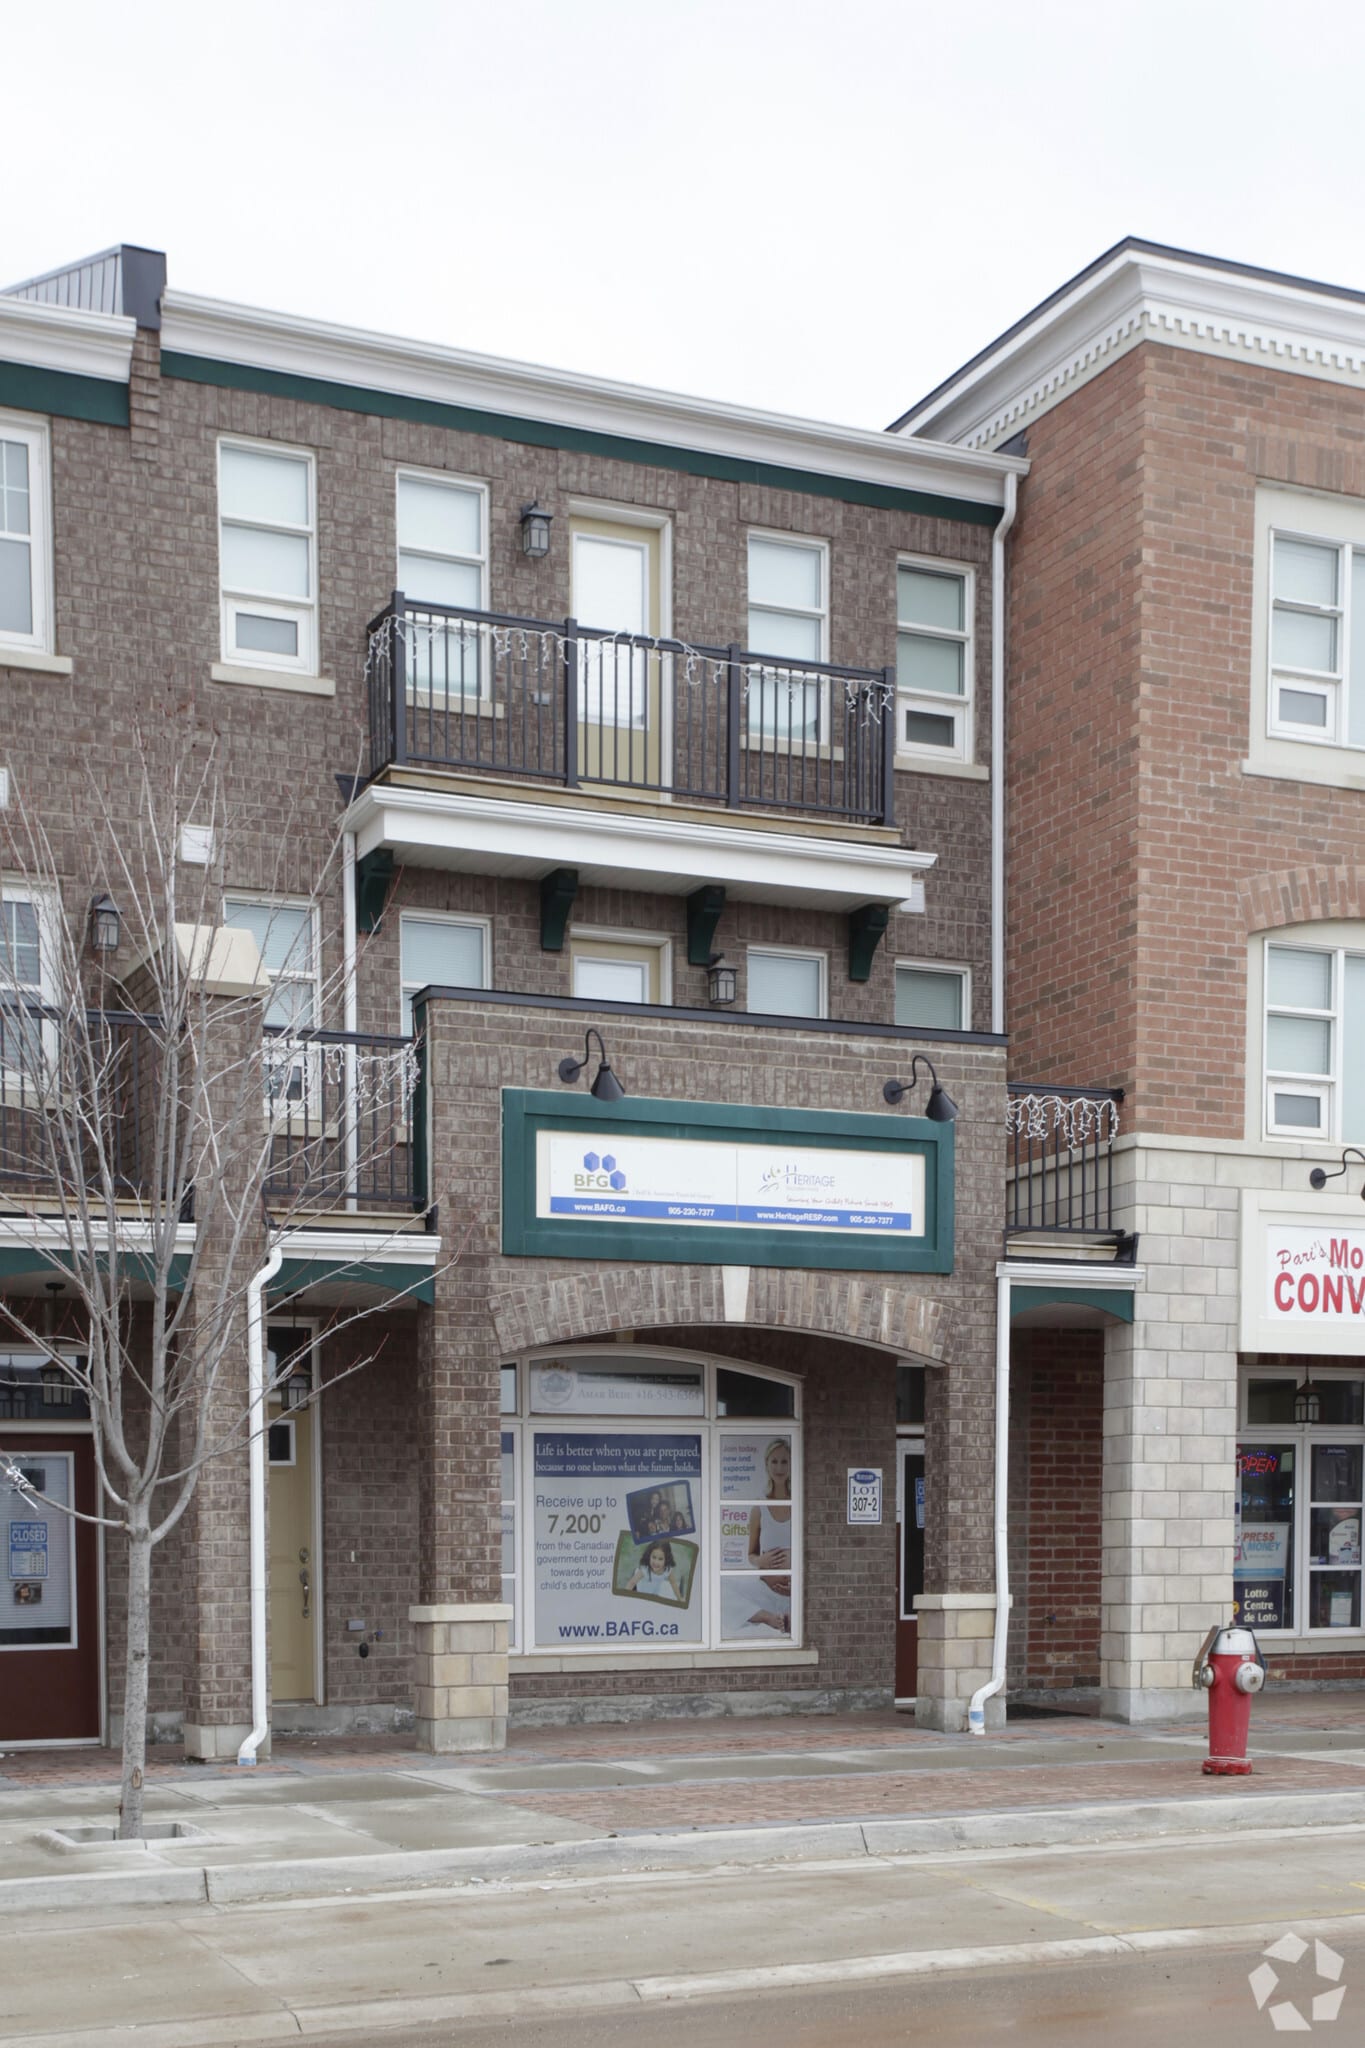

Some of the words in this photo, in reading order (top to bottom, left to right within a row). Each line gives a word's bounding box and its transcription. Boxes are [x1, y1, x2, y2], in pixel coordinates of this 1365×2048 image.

[574, 1173, 609, 1188] BFG
[786, 1164, 836, 1187] HERITAGE
[574, 1203, 626, 1213] www.BAFG.ca
[757, 1211, 839, 1223] www.HeritageRESP.com
[1276, 1241, 1327, 1270] Pari's
[536, 1443, 555, 1457] Life
[556, 1444, 565, 1457] is
[566, 1443, 593, 1457] better
[595, 1443, 621, 1457] when
[623, 1447, 641, 1460] you
[643, 1447, 657, 1457] are
[536, 1461, 564, 1472] because
[566, 1464, 576, 1472] no
[577, 1463, 591, 1472] one
[593, 1461, 617, 1472] knows
[618, 1461, 636, 1472] what
[638, 1461, 649, 1472] the
[651, 1461, 673, 1472] future
[1240, 1456, 1277, 1473] OPEN
[852, 1486, 878, 1495] LOT
[536, 1495, 583, 1508] Receive
[588, 1498, 602, 1510] up
[606, 1496, 617, 1508] to
[852, 1497, 877, 1511] 307-2
[722, 1509, 747, 1520] Free
[12, 1531, 46, 1541] CLOSED
[536, 1541, 556, 1550] from
[558, 1541, 571, 1550] the
[573, 1541, 614, 1550] Canadian
[536, 1556, 587, 1566] government
[590, 1556, 598, 1564] to
[600, 1556, 613, 1566] put
[550, 1568, 584, 1577] towards
[587, 1569, 605, 1578] your
[540, 1581, 567, 1590] child's
[569, 1581, 611, 1590] education
[1244, 1588, 1268, 1599] Lotto
[1244, 1600, 1273, 1611] Centre
[1244, 1612, 1255, 1622] de
[1258, 1612, 1278, 1623] Loto
[558, 1620, 679, 1637] www.BAFG.ca
